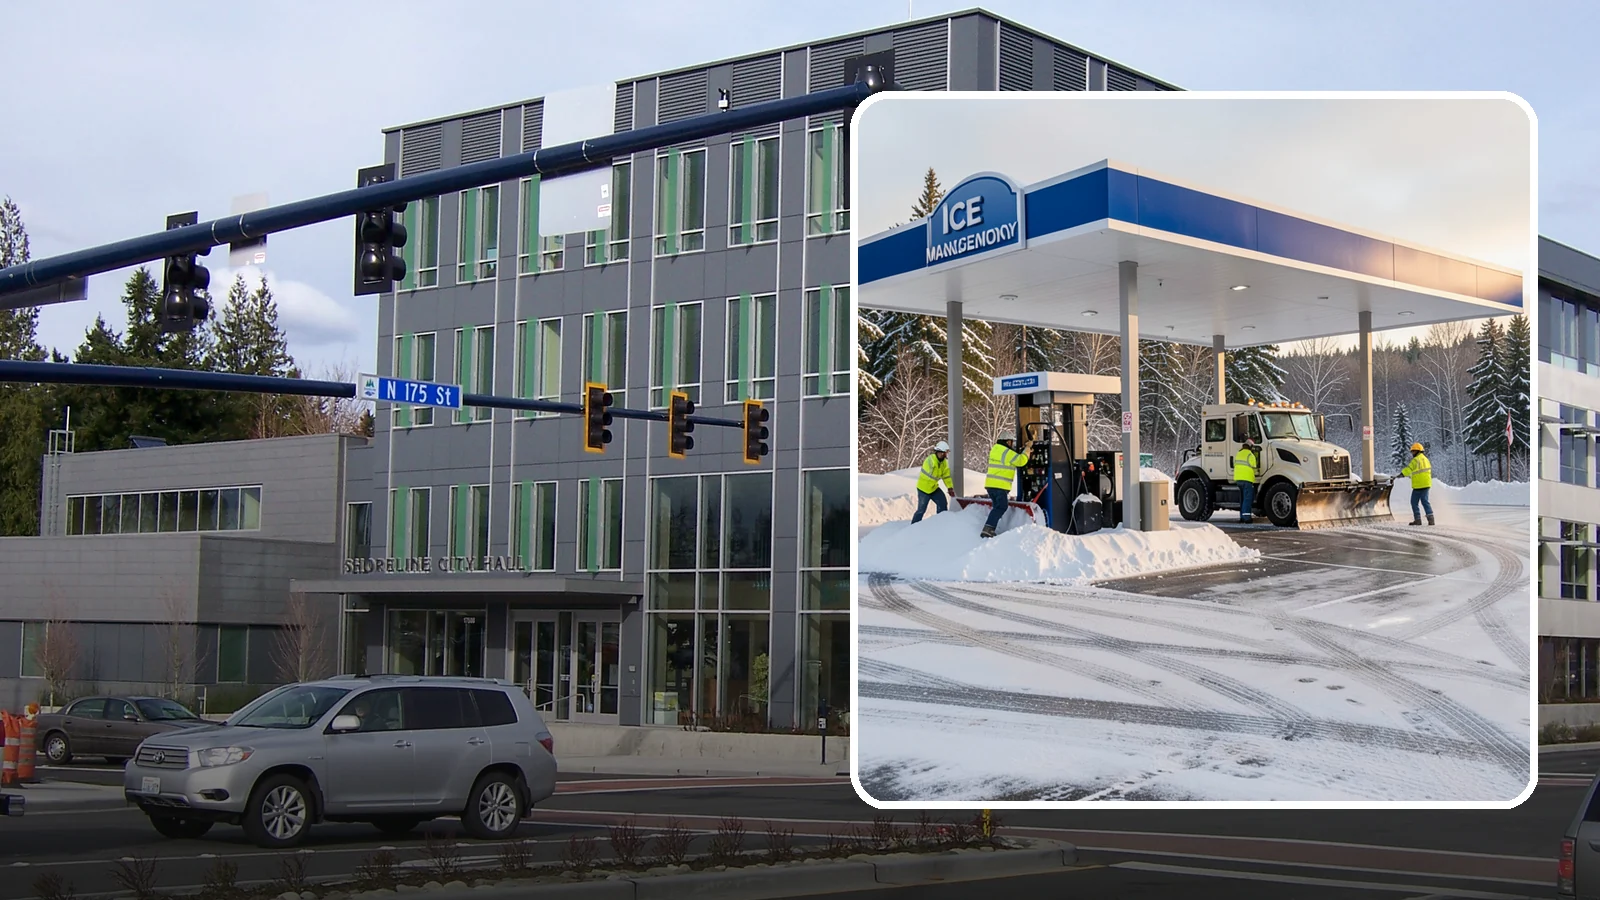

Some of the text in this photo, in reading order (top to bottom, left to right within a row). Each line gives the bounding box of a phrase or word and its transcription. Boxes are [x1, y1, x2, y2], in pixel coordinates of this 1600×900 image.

[943, 196, 982, 235] ICE
[387, 380, 452, 406] N 175 St
[344, 554, 526, 574] SHORELINE CITY HALL
